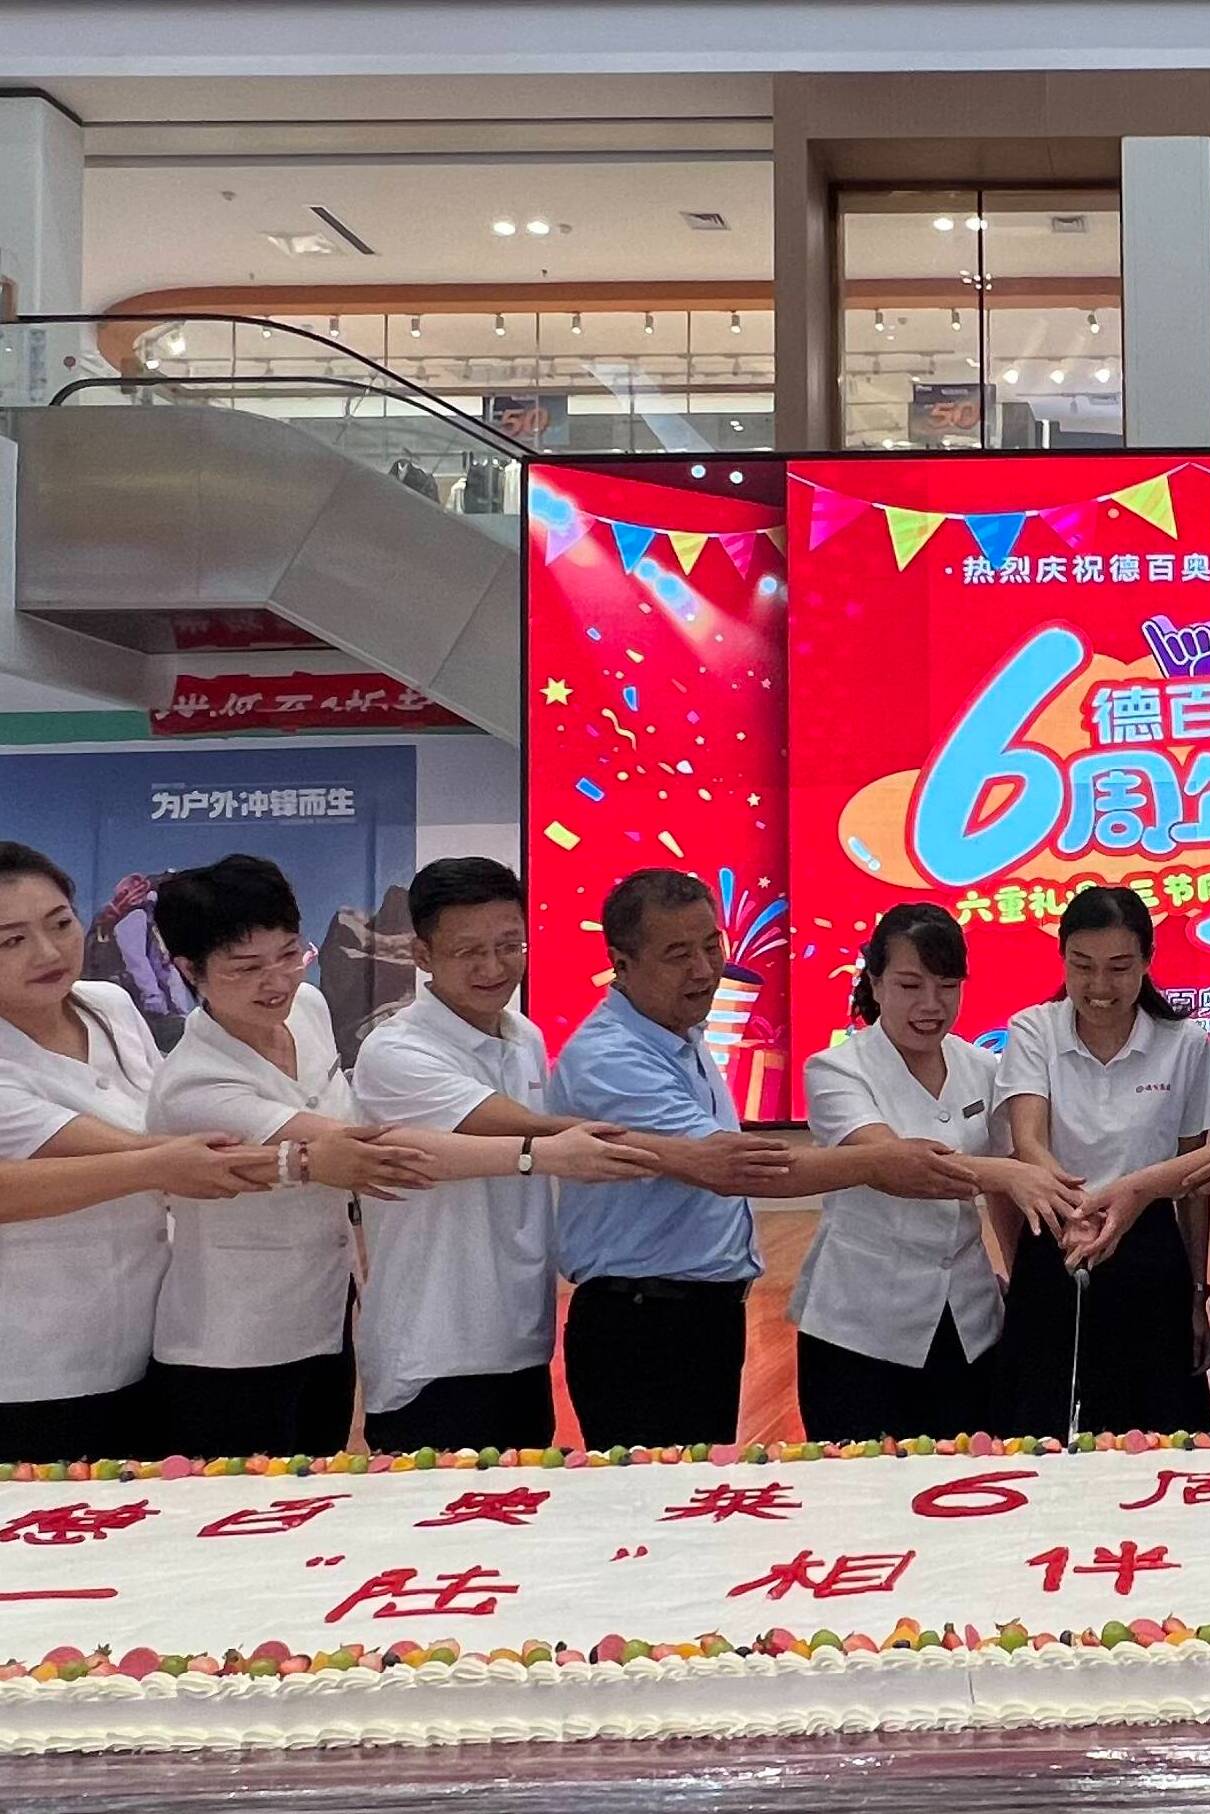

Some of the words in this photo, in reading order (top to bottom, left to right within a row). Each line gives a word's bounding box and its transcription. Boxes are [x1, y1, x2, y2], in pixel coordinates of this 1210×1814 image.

[151, 788, 355, 820] 为户外冲锋而生
[956, 879, 1098, 926] 六重礼
